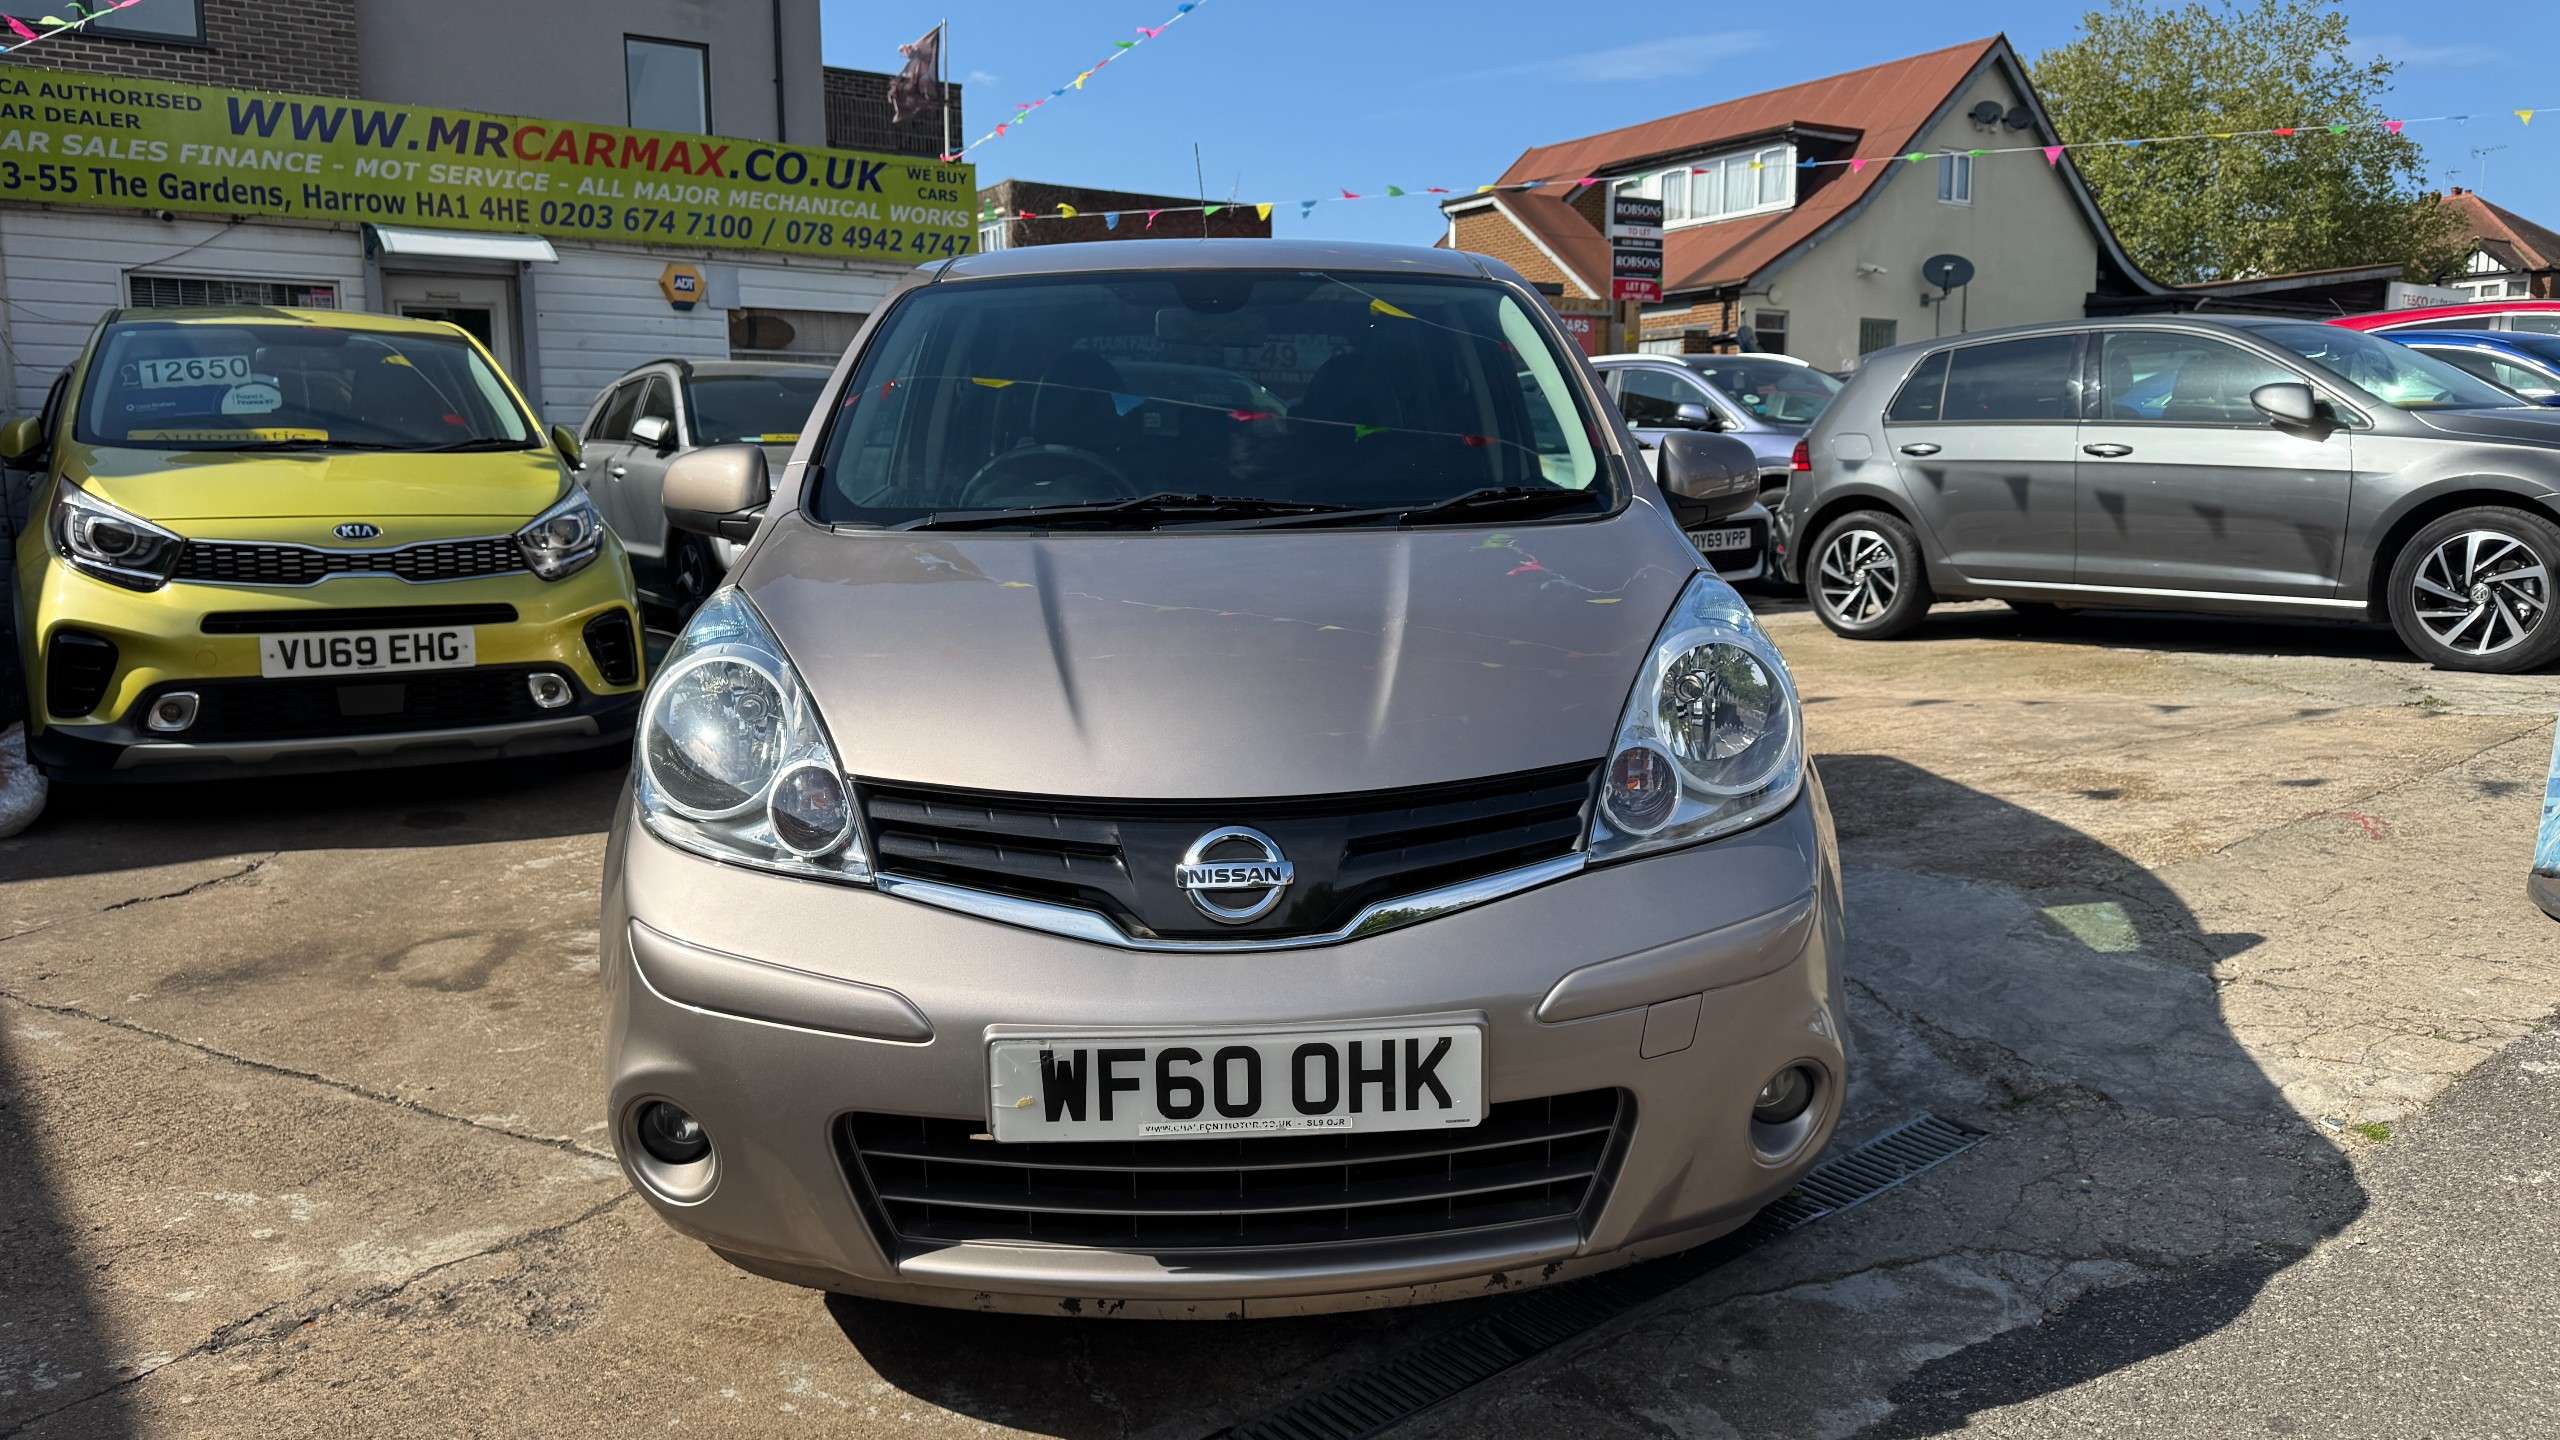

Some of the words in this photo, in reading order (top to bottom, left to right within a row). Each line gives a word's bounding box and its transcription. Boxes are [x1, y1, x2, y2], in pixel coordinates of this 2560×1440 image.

[39, 82, 203, 112] AUTHORISED
[44, 106, 142, 130] DEALER
[227, 96, 888, 193] WWW.MRCARMAX.CO.UK
[0, 129, 50, 154] AR
[62, 133, 169, 163] SALES
[179, 143, 324, 175] FINANCE
[354, 158, 421, 182] MOT
[427, 164, 550, 191] SERVICE
[577, 176, 625, 198] ALL
[634, 181, 720, 206] MAJOR
[728, 187, 881, 221] MECHANICAL
[889, 204, 970, 229] WORKS
[907, 166, 932, 182] WE
[936, 168, 968, 185] BUY
[917, 186, 958, 202] CARS
[87, 166, 148, 198] The
[158, 172, 292, 213] Gardens,
[302, 182, 406, 216] Harrow
[415, 191, 470, 220] HA1
[479, 196, 530, 224] 4HE
[539, 200, 614, 230] 0203
[623, 207, 676, 235] 674
[686, 211, 753, 240] 7100
[785, 220, 834, 247] 078
[842, 225, 904, 252] 4942
[910, 231, 972, 256] 4747
[1616, 203, 1662, 217] ROBSONS
[1615, 256, 1661, 269] ROBSONS
[674, 276, 695, 290] ADT
[341, 525, 375, 538] KIA
[277, 636, 378, 670] VU69
[388, 632, 460, 665] EHG
[1188, 866, 1281, 884] NISSAN
[1039, 1045, 1263, 1123] WF60
[1291, 1037, 1454, 1116] OHK
